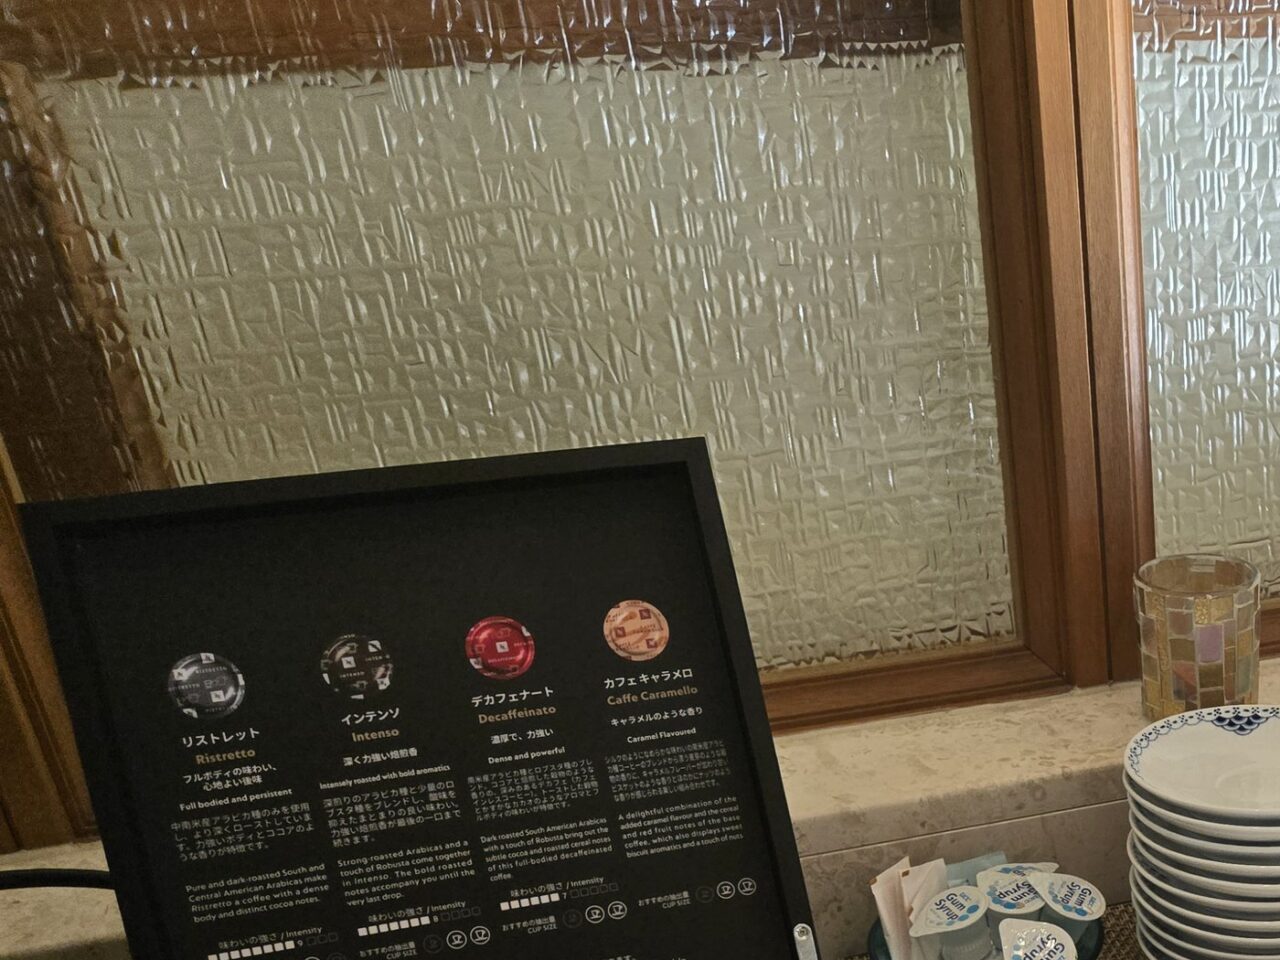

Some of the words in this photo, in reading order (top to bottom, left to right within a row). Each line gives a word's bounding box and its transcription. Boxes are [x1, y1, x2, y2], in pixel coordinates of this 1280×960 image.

[604, 677, 637, 689] カフェ
[639, 668, 693, 684] キャラメロ
[471, 687, 553, 707] デカフェナート
[607, 693, 638, 705] Caffe
[640, 686, 698, 701] Caramello
[341, 708, 400, 725] インテンソ
[478, 706, 556, 724] Decaffeinato
[182, 728, 259, 747] リストレット
[352, 729, 399, 742] Intenso
[627, 732, 659, 743] Caramel
[659, 727, 696, 738] Flavoured
[195, 749, 256, 764] Ristretto
[488, 755, 513, 764] Dense
[514, 751, 530, 760] and
[530, 746, 565, 759] powerful
[319, 779, 353, 789] Intensely
[353, 774, 381, 784] roasted
[381, 771, 398, 780] with
[398, 769, 416, 778] bold
[416, 765, 451, 775] aromatics
[179, 802, 197, 811] Full
[197, 797, 230, 808] bodied
[231, 794, 248, 803] and
[249, 789, 292, 802] persistent
[945, 892, 967, 912] Gum
[1060, 881, 1081, 905] Syrup
[1074, 887, 1093, 907] Gum
[934, 898, 959, 921] Syrup
